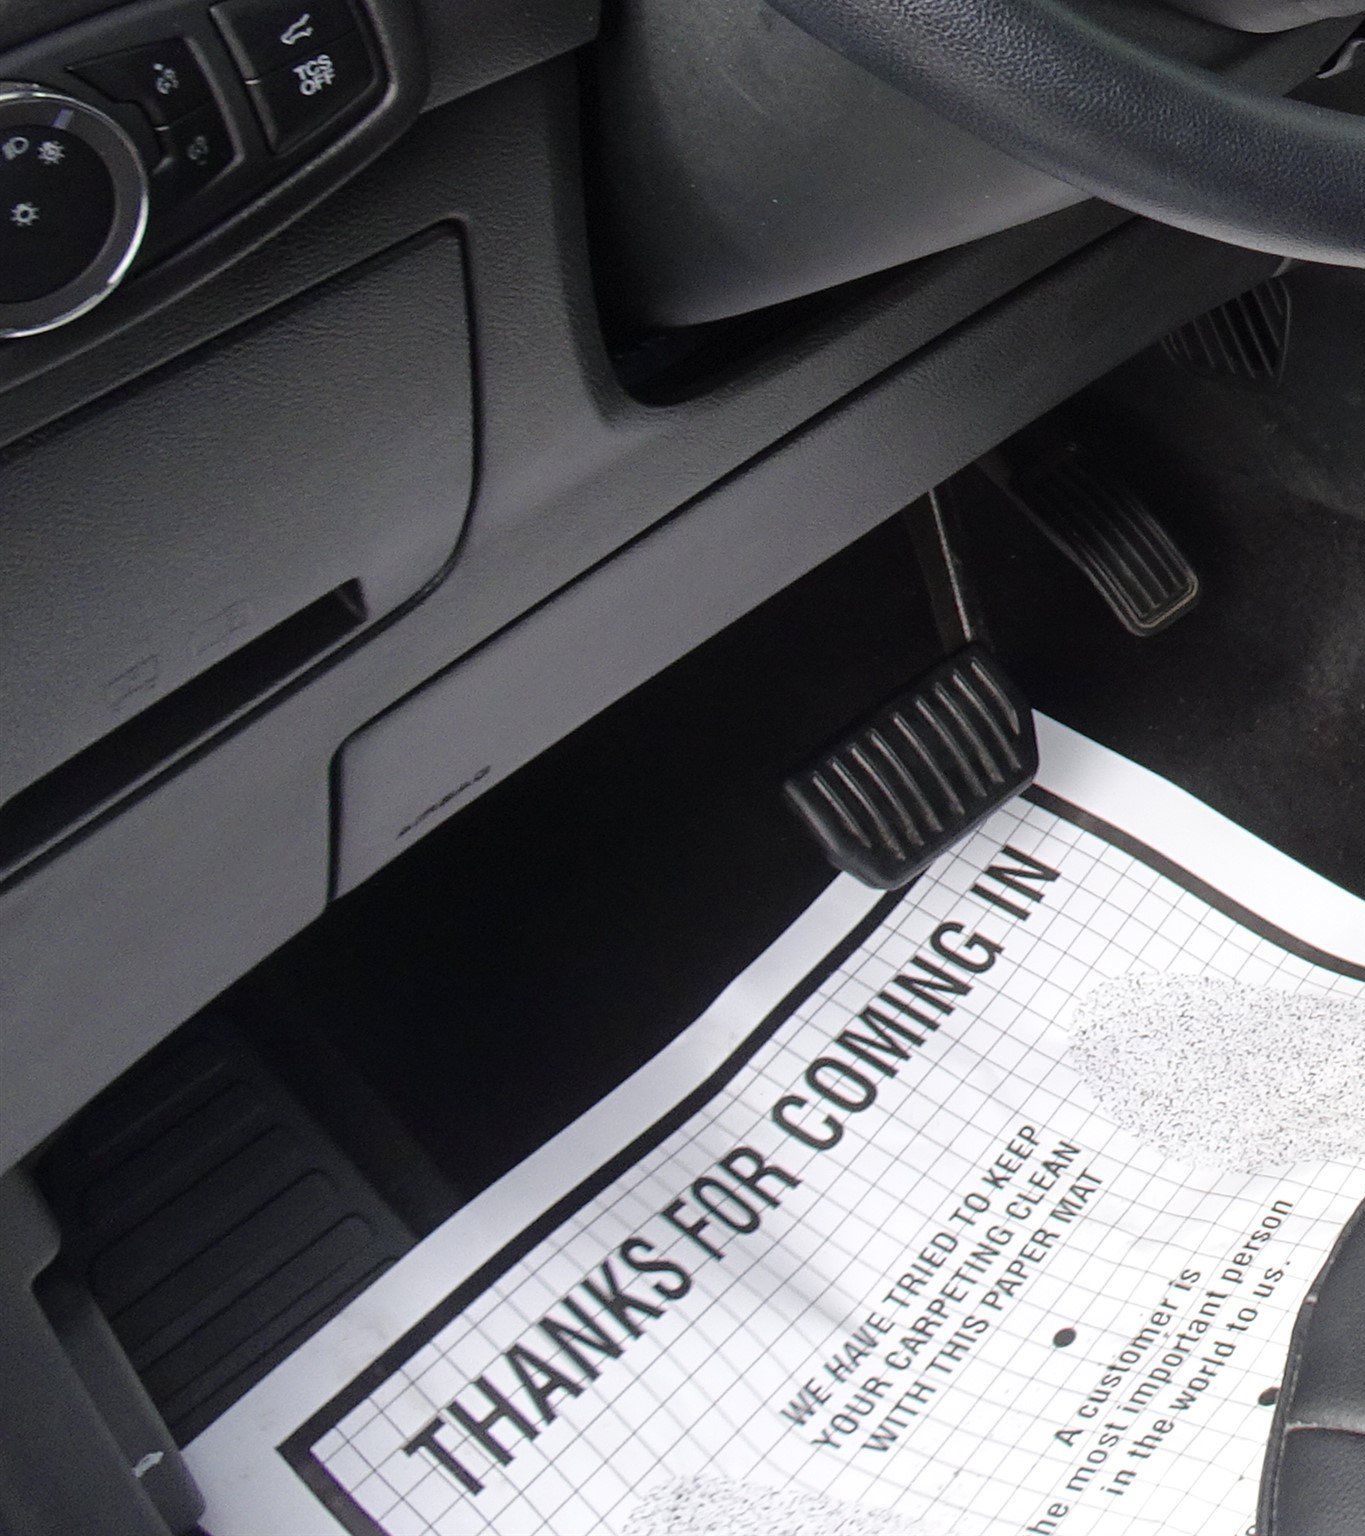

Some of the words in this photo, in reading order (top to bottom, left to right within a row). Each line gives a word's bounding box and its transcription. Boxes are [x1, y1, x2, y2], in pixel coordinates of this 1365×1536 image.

[403, 1237, 693, 1497] THANKS
[660, 1146, 804, 1262] FOR
[771, 921, 1006, 1152] COMING
[970, 846, 1061, 922] IN
[780, 1378, 832, 1426] WE
[824, 1312, 895, 1383] HAVE
[883, 1231, 959, 1307] TRIED
[949, 1193, 990, 1225] TO
[982, 1124, 1040, 1190] KEEP
[811, 1377, 893, 1450] YOUR
[885, 1225, 1014, 1370] CARPETING
[1006, 1140, 1081, 1221] CLEAN
[861, 1381, 936, 1453] WITH
[926, 1315, 989, 1373] THIS
[981, 1228, 1060, 1311] PAPER
[1050, 1168, 1103, 1224] MAT
[1022, 1502, 1069, 1536] he
[1065, 1422, 1128, 1492] most
[1117, 1290, 1228, 1415] important
[1221, 1200, 1294, 1285] person
[1054, 1428, 1084, 1448] A
[1077, 1297, 1179, 1420] customer
[1169, 1268, 1202, 1292] is
[1100, 1469, 1137, 1496] in
[1127, 1418, 1174, 1459] the
[1169, 1341, 1236, 1412] world
[1226, 1307, 1258, 1333] to
[1253, 1261, 1291, 1298] us.
